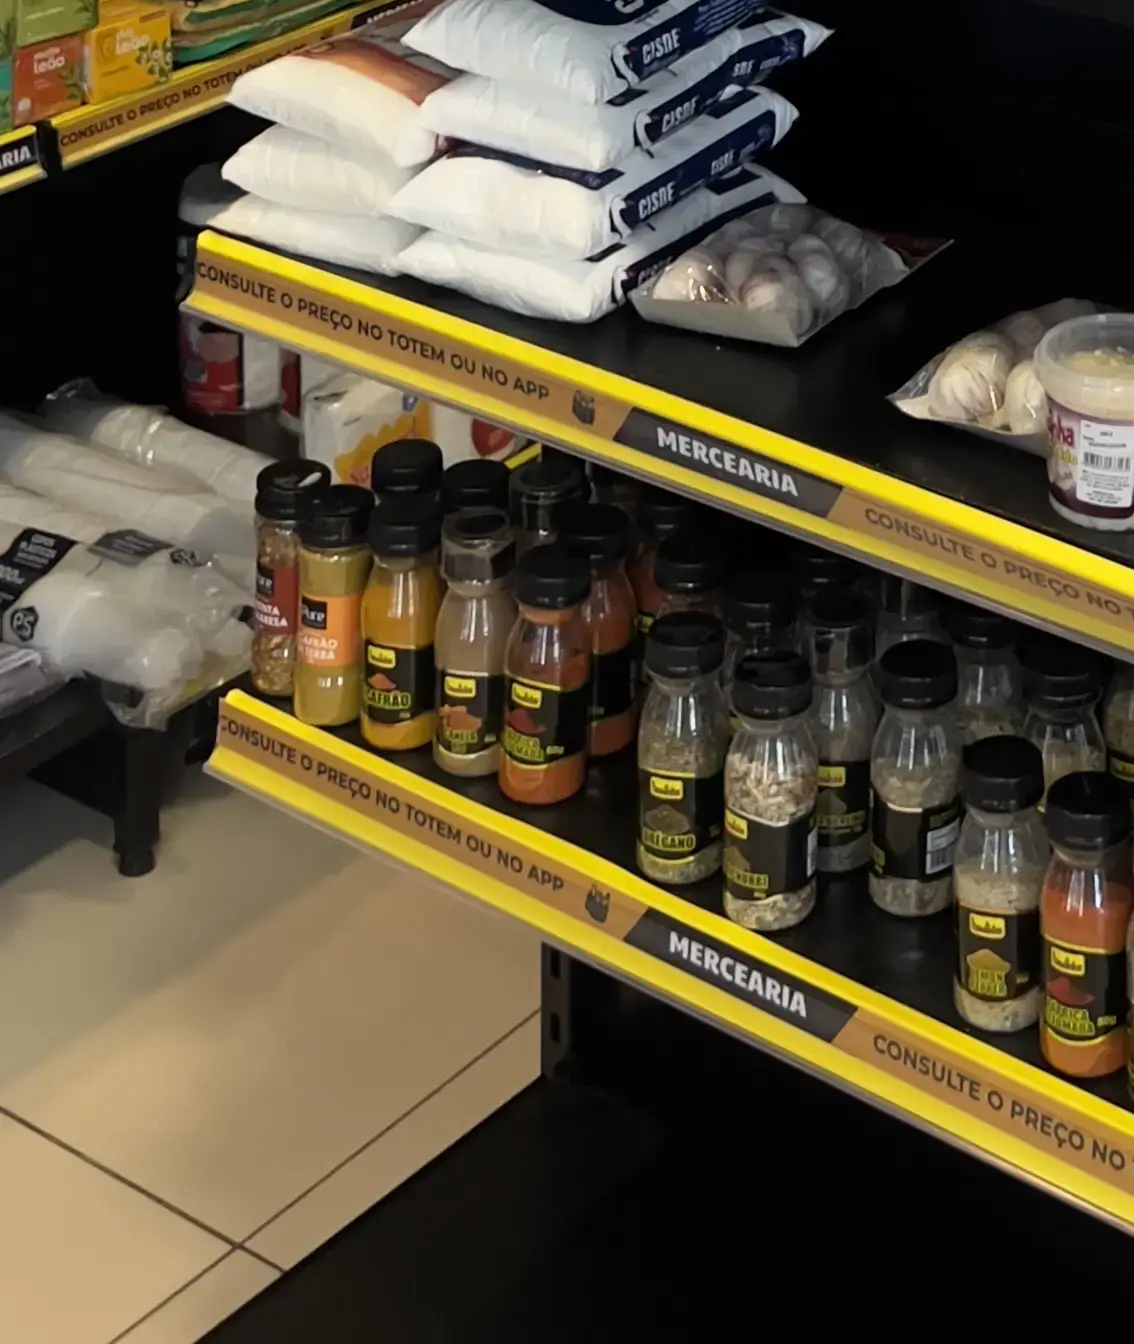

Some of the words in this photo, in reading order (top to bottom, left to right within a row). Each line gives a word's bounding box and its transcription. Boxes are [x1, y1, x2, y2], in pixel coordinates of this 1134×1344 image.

[34, 56, 66, 74] leão
[115, 34, 150, 55] leão
[641, 27, 681, 64] CISNE
[60, 112, 125, 147] CONSULTE
[126, 108, 137, 121] O
[139, 92, 181, 117] PREÇO
[182, 83, 202, 100] NO
[661, 95, 698, 133] CISNE
[638, 181, 677, 220] CISNE
[197, 261, 276, 303] CONSULTE
[280, 292, 294, 308] O
[297, 297, 353, 332] PREÇO
[358, 318, 384, 341] NO
[386, 328, 447, 365] TOTEM
[450, 351, 476, 375] OU
[482, 363, 508, 386] NO
[511, 377, 550, 402] APP
[656, 425, 799, 498] MERCEARIA
[864, 507, 976, 562] CONSULTE
[981, 551, 998, 569] O
[1003, 560, 1080, 599] PREÇO
[1085, 589, 1122, 615] NO
[300, 755, 314, 772] O
[316, 763, 372, 799] PREÇO
[375, 789, 401, 813] NO
[403, 802, 462, 844] TOTEM
[466, 835, 493, 860] OU
[497, 849, 523, 874] NO
[527, 864, 564, 893] APP
[668, 930, 808, 1019] MERCEARIA
[872, 1033, 982, 1102] CONSULTE
[986, 1089, 1004, 1111] O
[1009, 1098, 1085, 1152] PREÇO
[1090, 1137, 1127, 1172] NO
